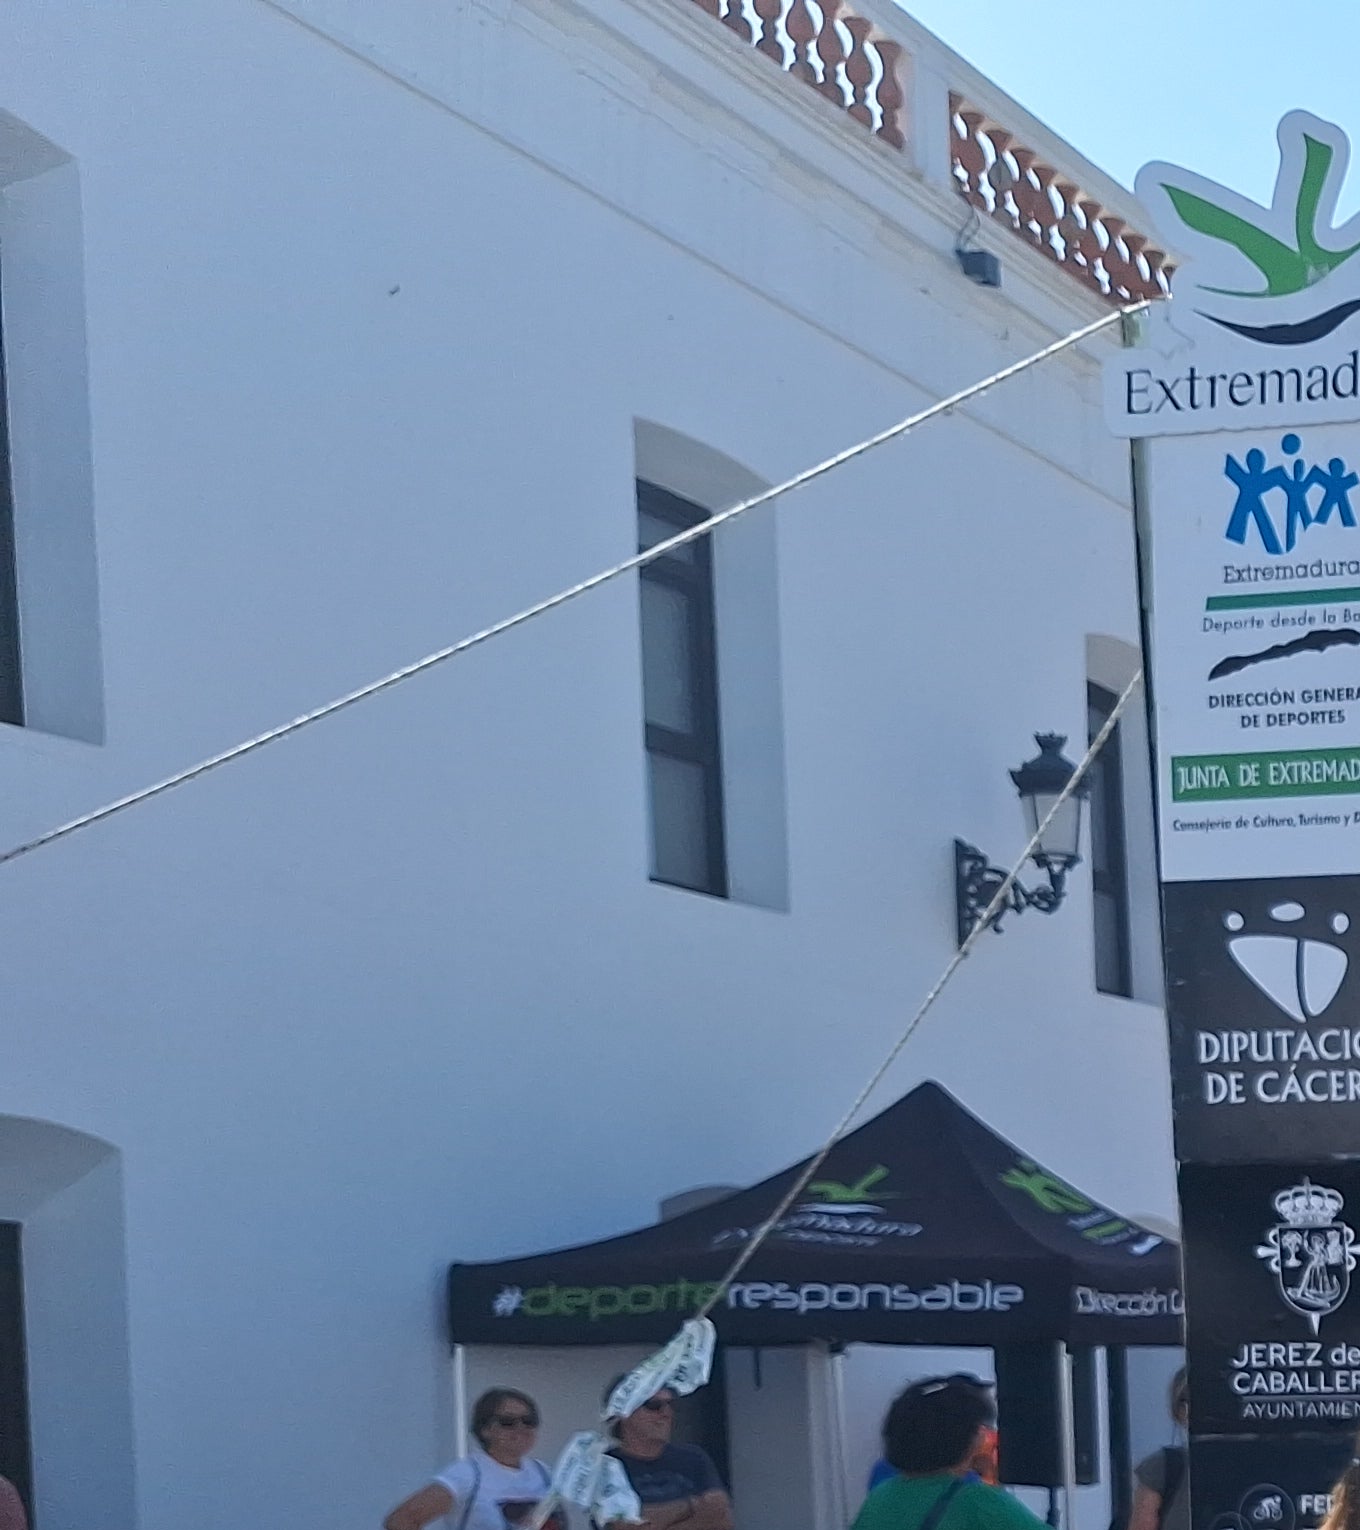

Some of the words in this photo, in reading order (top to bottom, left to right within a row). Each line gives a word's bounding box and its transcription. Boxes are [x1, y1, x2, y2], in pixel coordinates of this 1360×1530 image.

[1202, 616, 1265, 634] Deporte
[1270, 610, 1316, 629] desde
[1322, 609, 1336, 624] la
[1207, 688, 1296, 709] DIRECCIÓN
[1240, 715, 1261, 729] DE
[1266, 709, 1347, 727] DEPORTES
[1176, 765, 1231, 795] JUNTA
[1239, 763, 1261, 787] DE
[1234, 814, 1250, 829] de
[1342, 815, 1350, 827] y
[1206, 1070, 1246, 1105] DE
[1232, 1342, 1323, 1369] JEREZ
